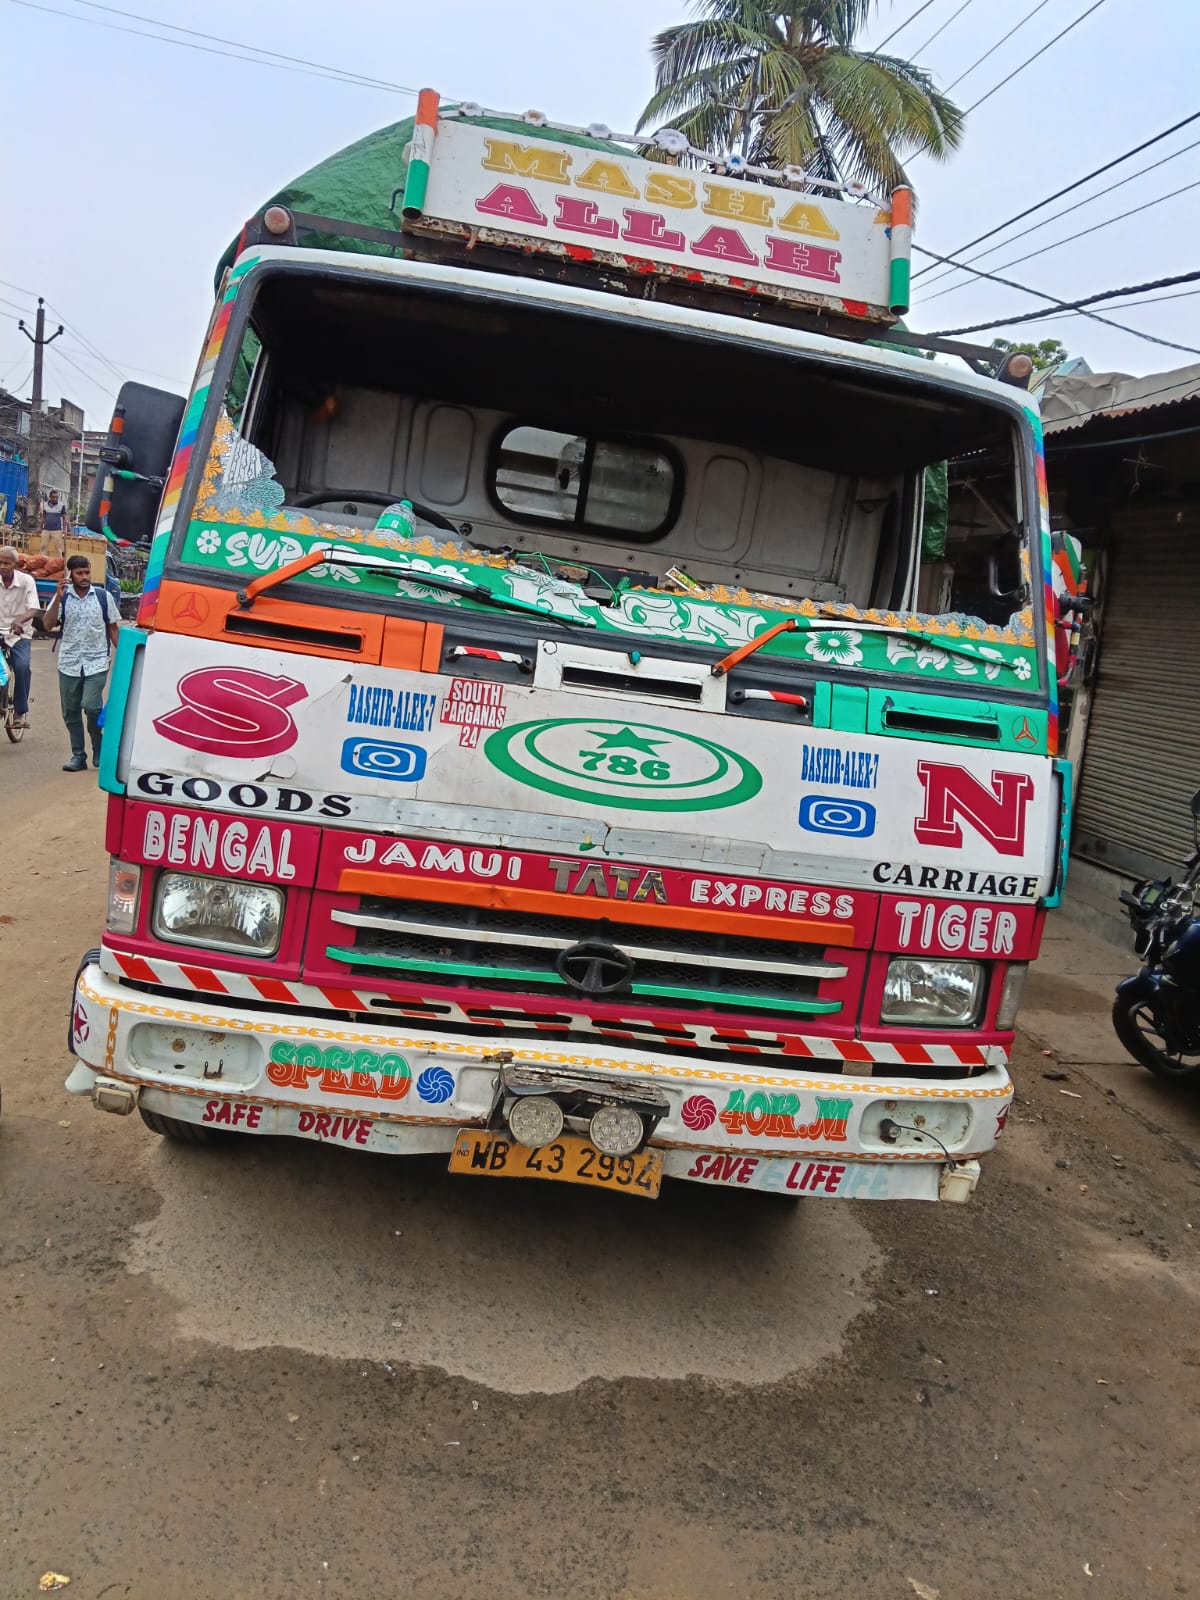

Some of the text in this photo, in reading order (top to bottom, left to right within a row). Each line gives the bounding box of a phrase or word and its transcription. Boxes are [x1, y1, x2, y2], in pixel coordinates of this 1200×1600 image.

[481, 137, 841, 241] MASHA
[475, 182, 843, 284] ALLAH
[152, 665, 310, 759] S
[441, 699, 506, 728] PARGANAS
[452, 679, 503, 705] SOUTH
[460, 725, 478, 748] 24
[579, 750, 671, 780] 786
[137, 772, 353, 818] GOODS
[913, 759, 1036, 857] N
[143, 810, 296, 880] BENGAL
[344, 838, 855, 919] JAMUI TATA EXPRESS
[872, 862, 1039, 898] CARRIAGE
[895, 901, 1018, 955] TIGER
[265, 1039, 413, 1101] SPEED
[202, 1100, 374, 1145] SAFE DRIVE
[471, 1140, 510, 1171] WB
[526, 1144, 566, 1174] 43
[688, 1154, 759, 1184] SAVE
[785, 1161, 847, 1194] LIFE
